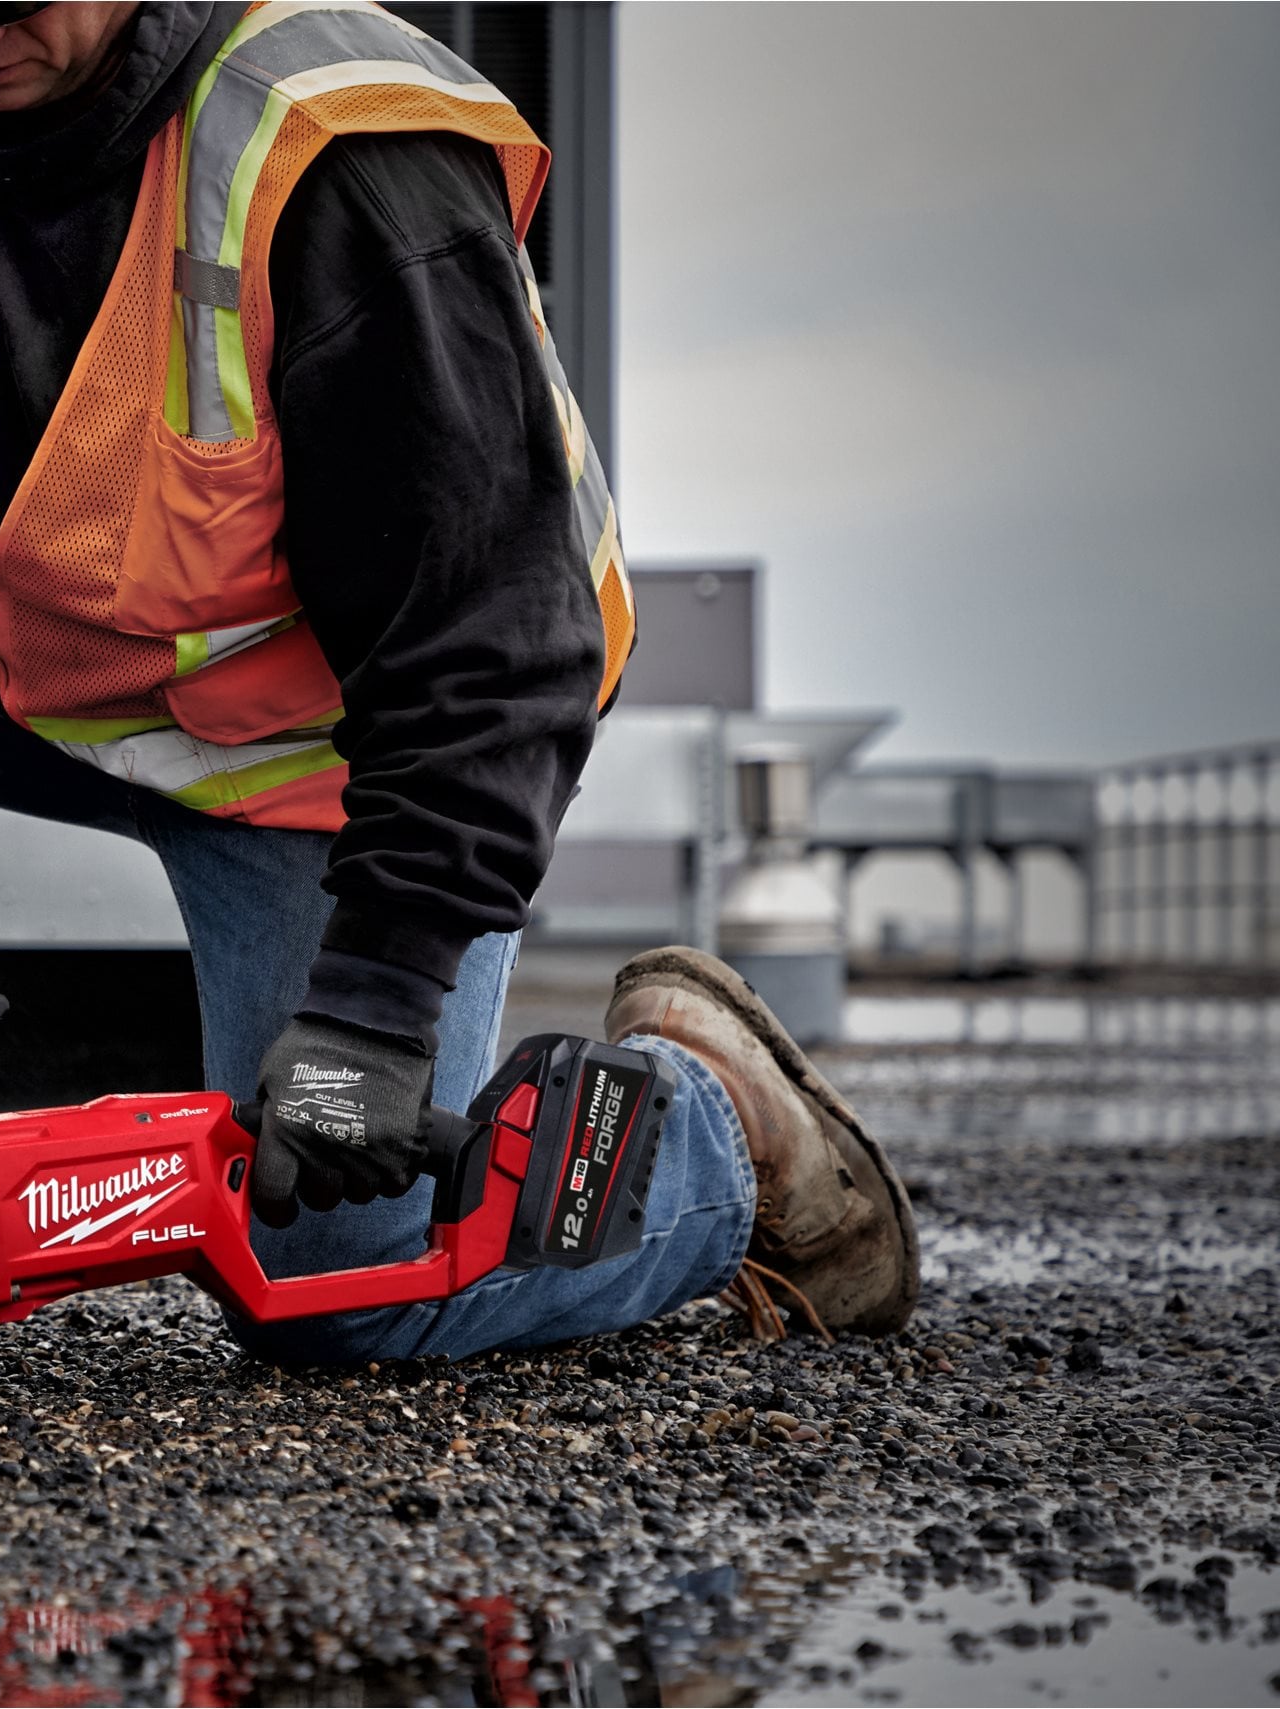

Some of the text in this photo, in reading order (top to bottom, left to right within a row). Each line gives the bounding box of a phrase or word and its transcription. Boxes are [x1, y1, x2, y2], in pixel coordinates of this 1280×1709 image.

[315, 1093, 332, 1102] CUT
[333, 1097, 358, 1108] LEVEL
[580, 1069, 607, 1157] REDLITHIUM
[299, 1111, 313, 1121] XL
[593, 1081, 624, 1165] FORGE
[572, 1161, 587, 1190] M18
[18, 1153, 187, 1234] Milwaukee
[131, 1224, 207, 1246] FUEL
